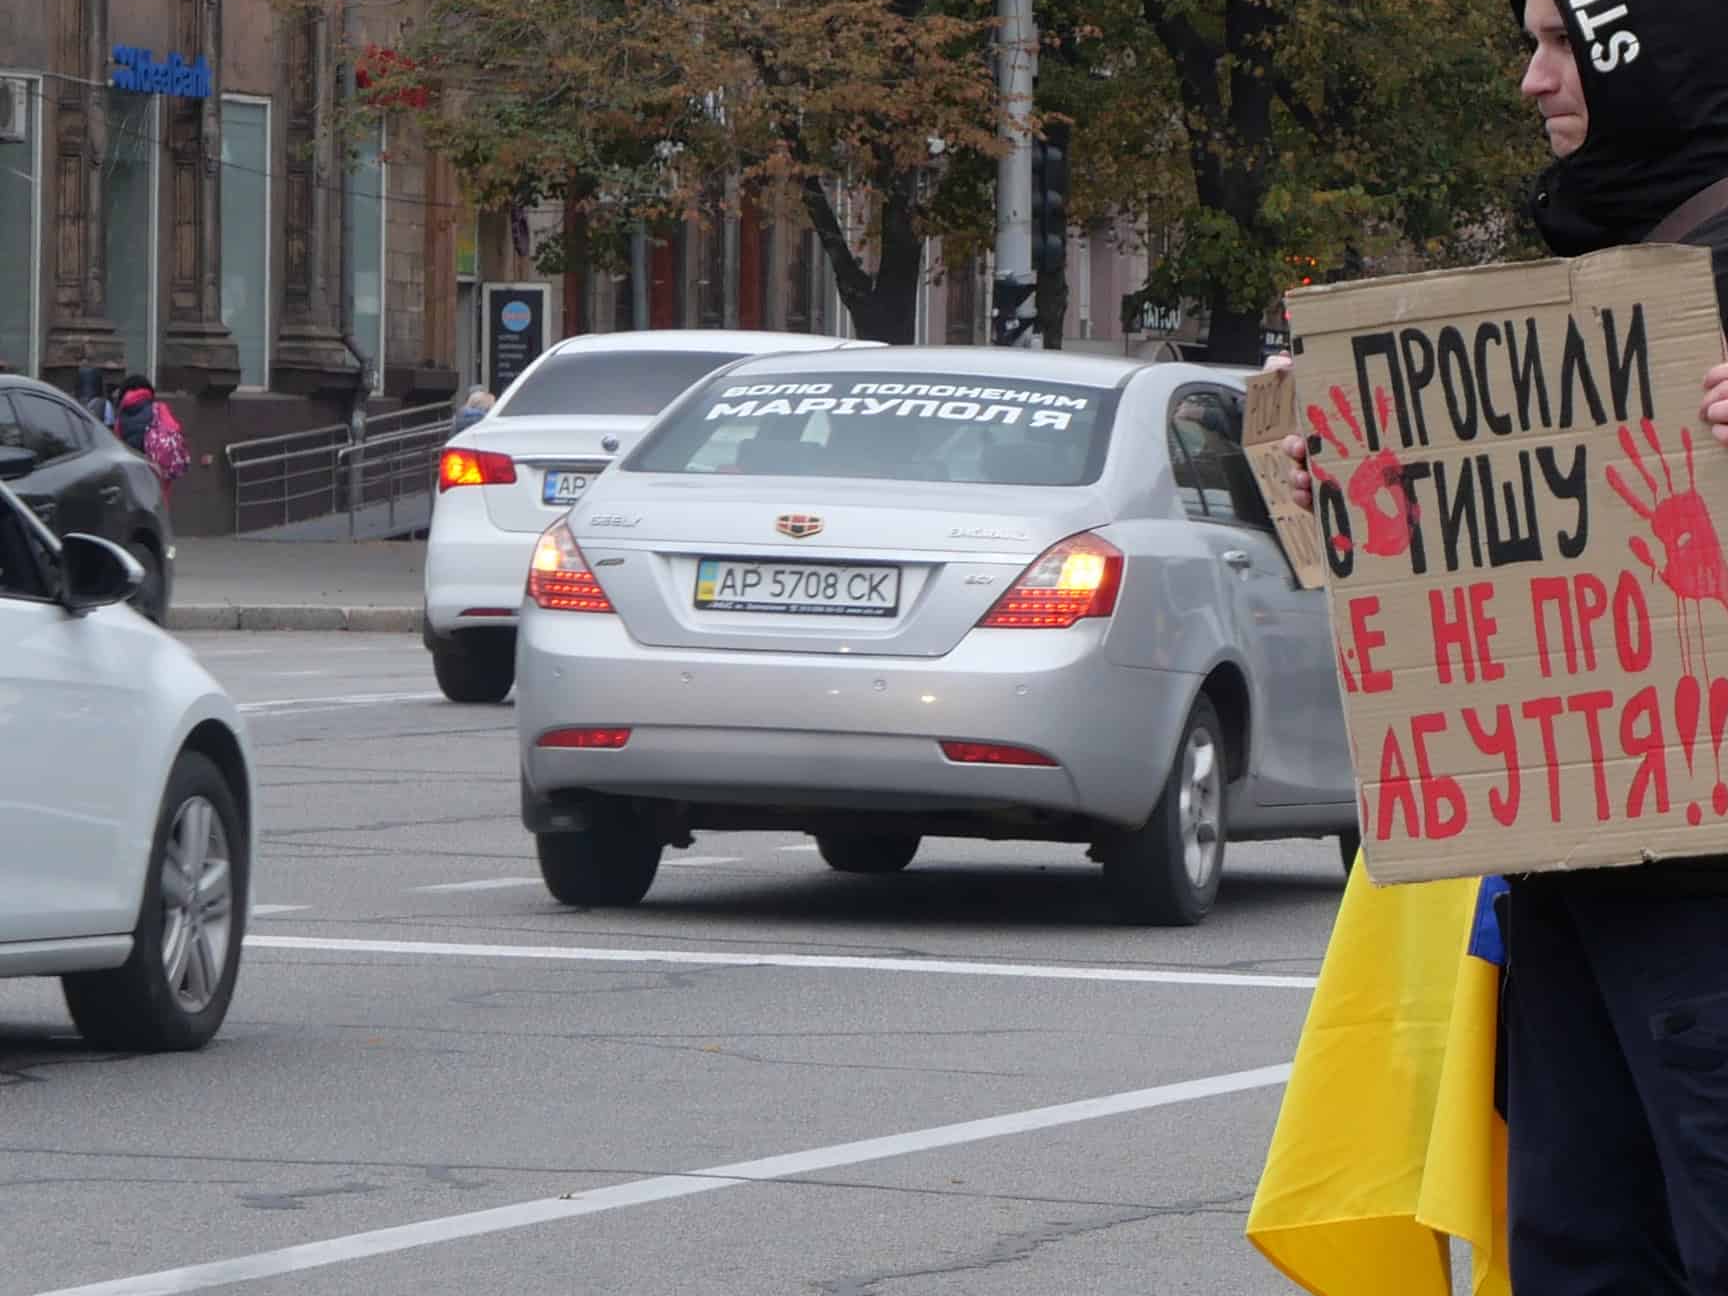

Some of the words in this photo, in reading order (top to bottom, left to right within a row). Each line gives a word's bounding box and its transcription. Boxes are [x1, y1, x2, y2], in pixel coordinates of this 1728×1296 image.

[721, 382, 833, 399] ВОЛЮ
[850, 382, 1088, 411] ПОЛОНЕНИМ
[1351, 302, 1654, 452] ПРОСИЛИ
[1384, 444, 1588, 575] ТИШУ
[719, 567, 762, 597] AP
[770, 569, 839, 600] 5708
[846, 572, 890, 602] CK
[1429, 581, 1505, 685] НЕ
[1531, 570, 1654, 679] ПРО
